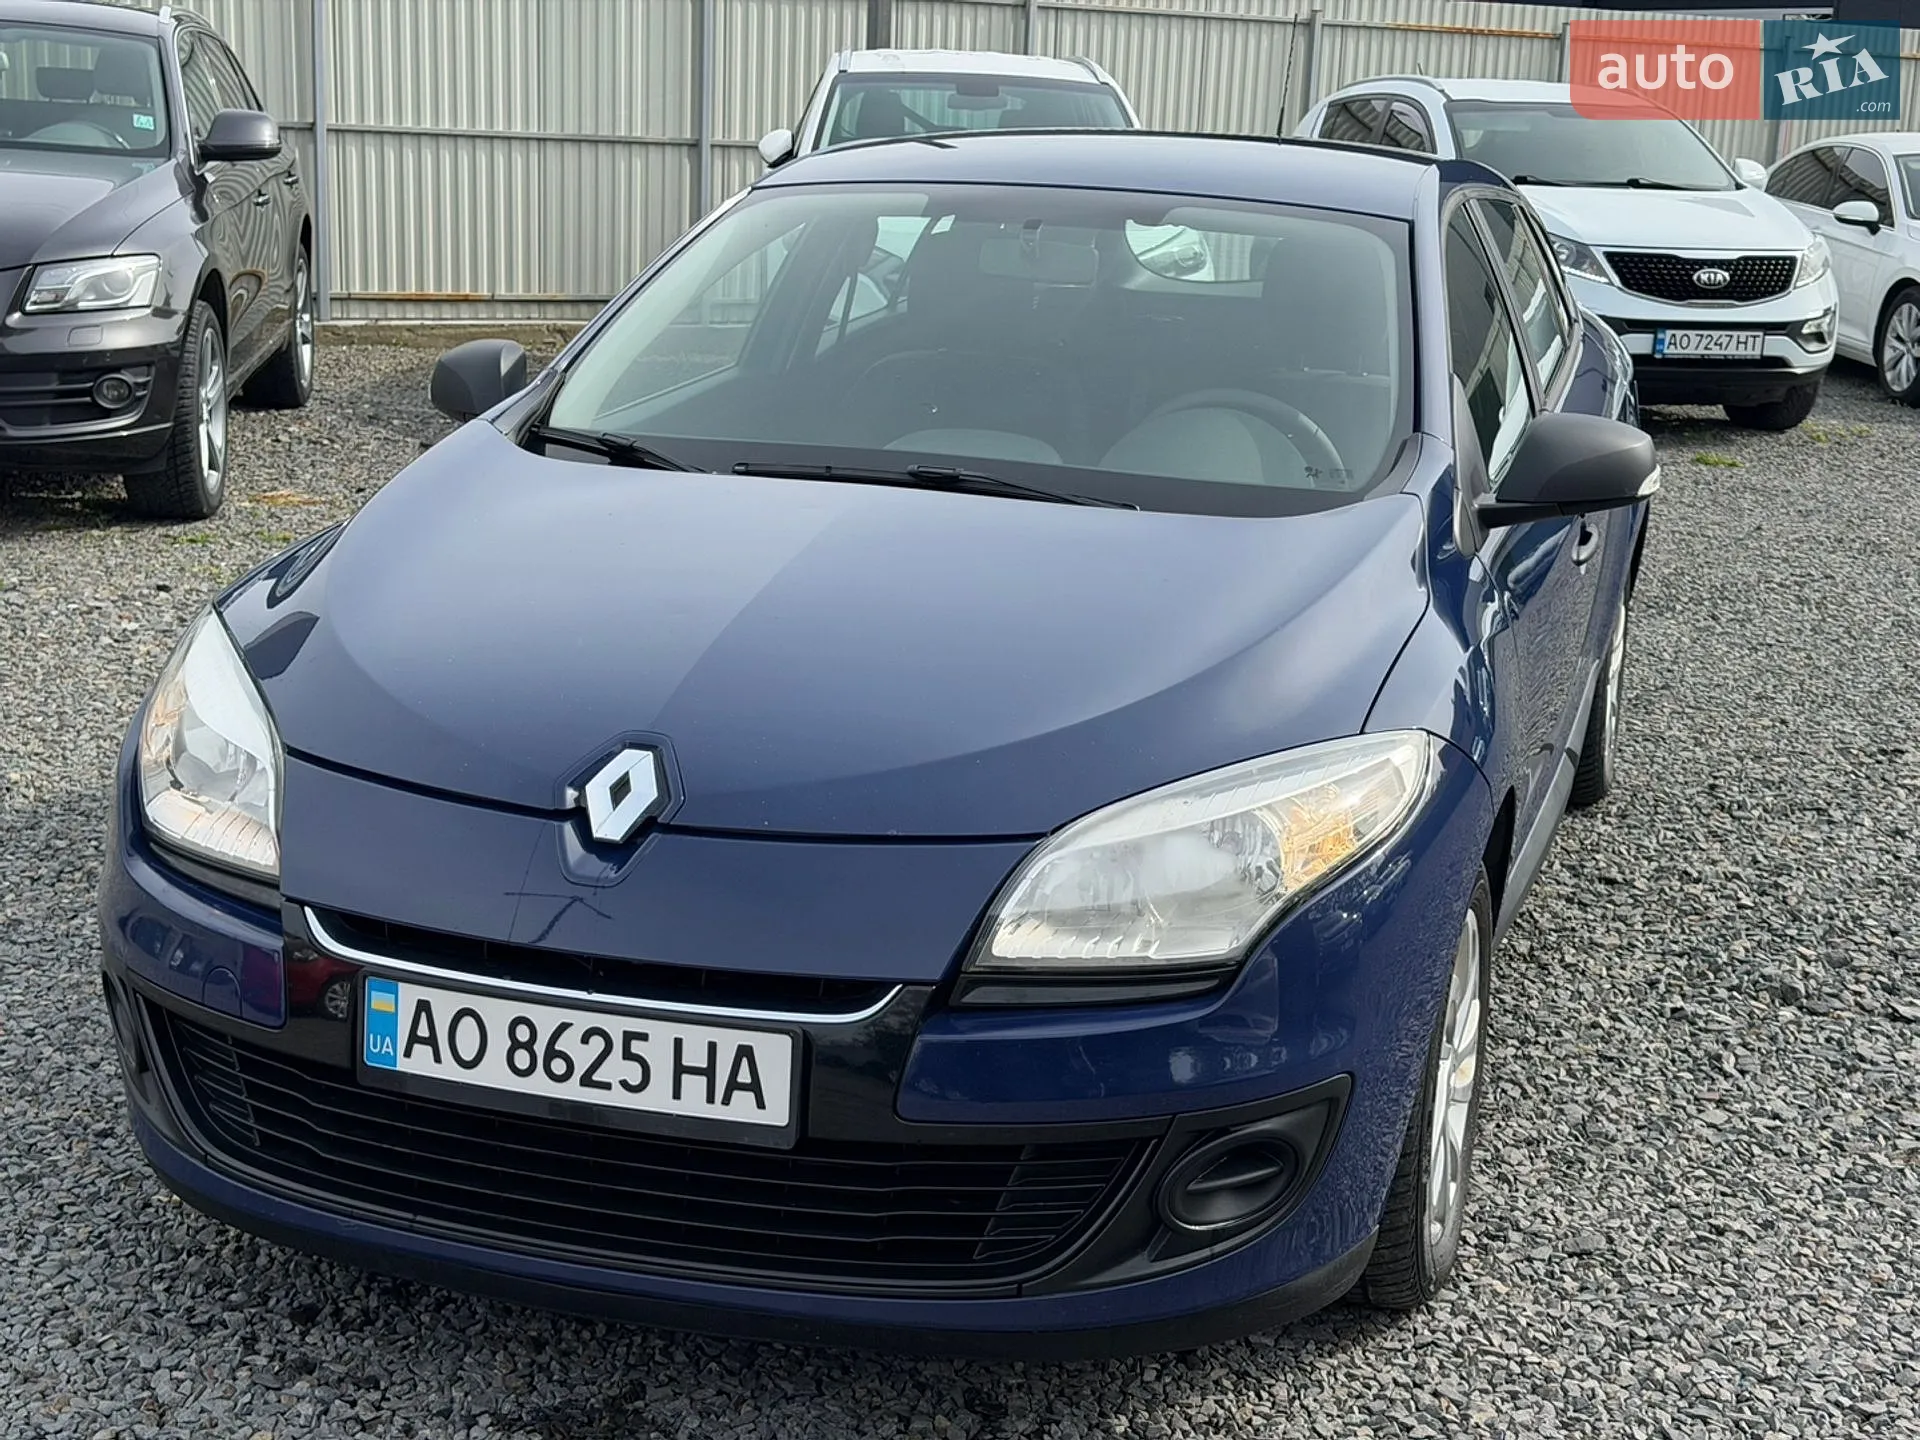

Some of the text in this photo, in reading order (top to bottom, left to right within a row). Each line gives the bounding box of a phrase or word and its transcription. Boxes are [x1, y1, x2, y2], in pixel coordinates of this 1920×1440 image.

[1700, 273, 1724, 285] KIA
[1666, 333, 1761, 352] AO 7247 HT
[369, 1033, 394, 1057] UA
[402, 998, 767, 1111] AO 8625 HA
